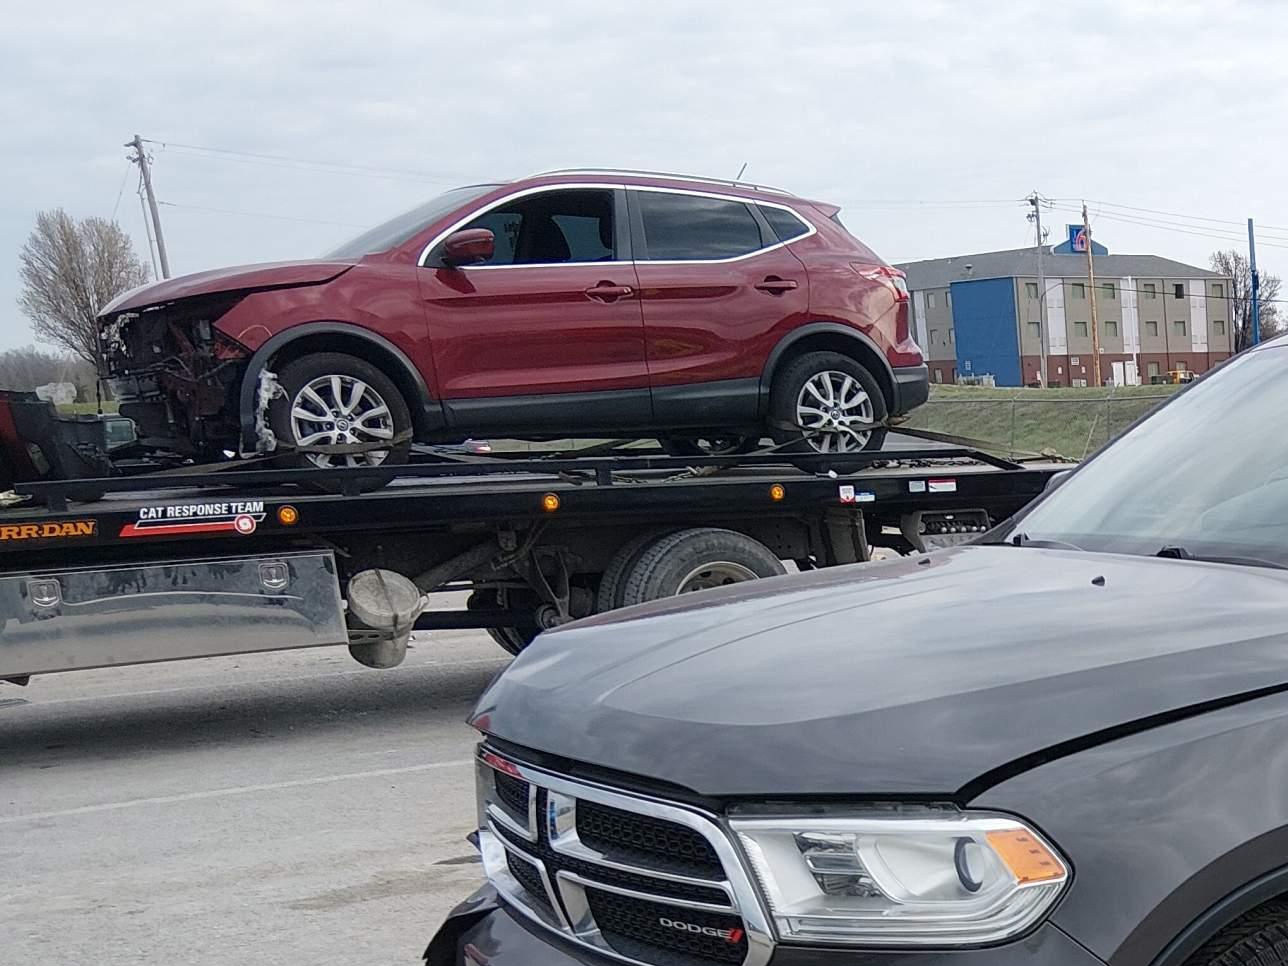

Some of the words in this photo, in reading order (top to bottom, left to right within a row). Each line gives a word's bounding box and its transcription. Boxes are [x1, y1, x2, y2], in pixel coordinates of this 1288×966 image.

[139, 507, 164, 519] CAT
[166, 503, 229, 517] RESPONSE
[230, 501, 264, 514] TEAM
[659, 917, 732, 939] DODGE
